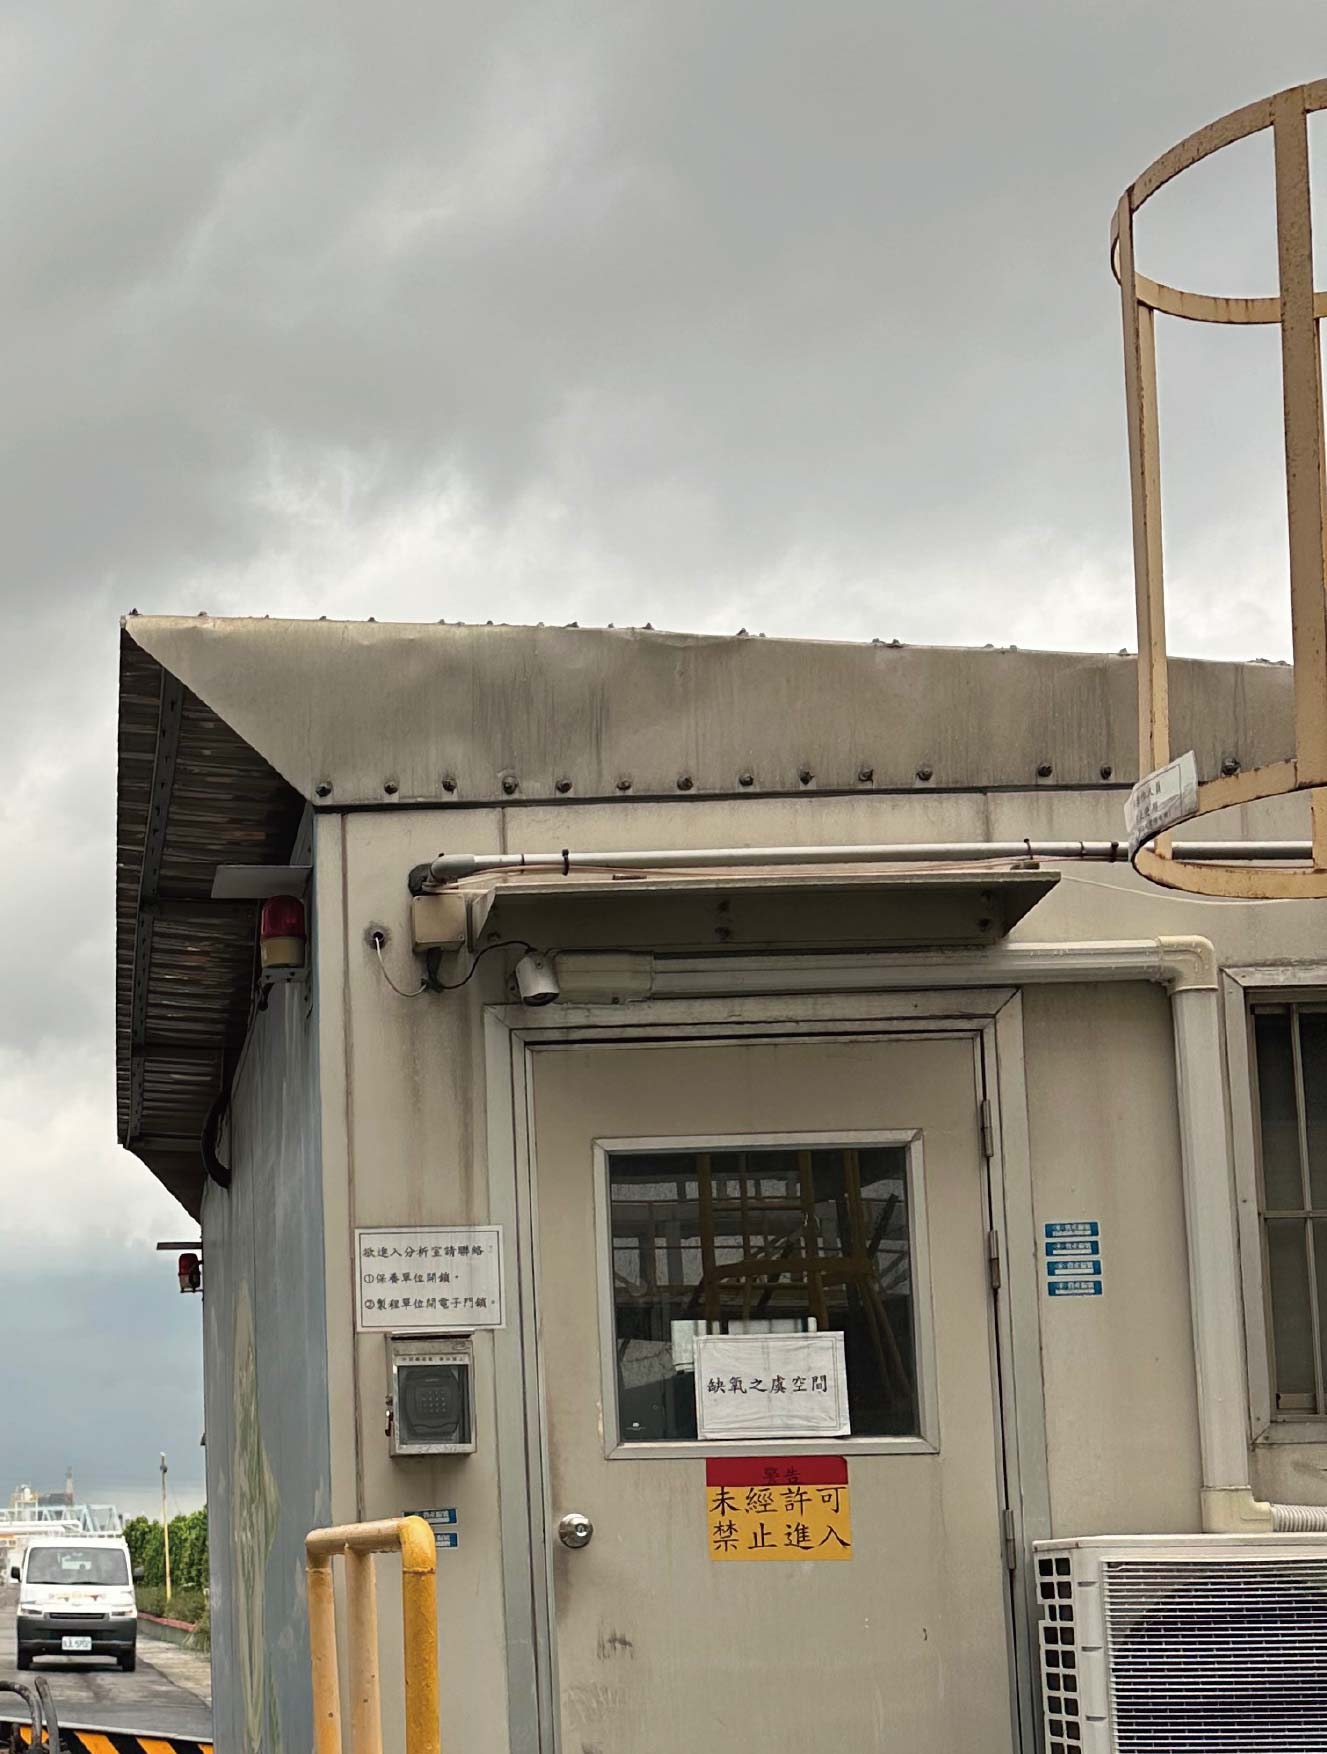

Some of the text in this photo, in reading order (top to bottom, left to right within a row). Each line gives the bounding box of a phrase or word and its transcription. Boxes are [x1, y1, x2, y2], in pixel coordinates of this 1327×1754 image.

[709, 1485, 847, 1517] 未經許可
[712, 1519, 852, 1553] 禁止進入
